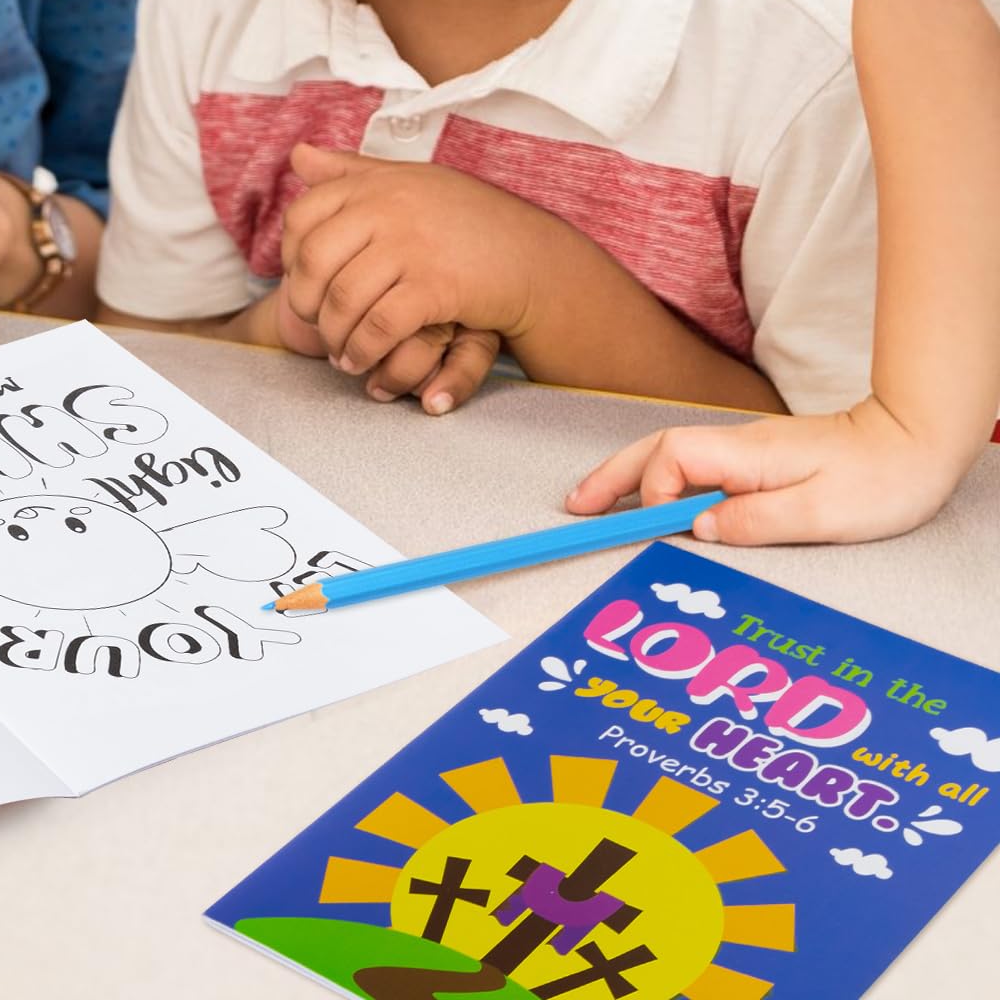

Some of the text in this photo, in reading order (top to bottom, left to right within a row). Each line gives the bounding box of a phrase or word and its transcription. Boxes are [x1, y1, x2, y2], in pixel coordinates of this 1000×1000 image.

[82, 446, 241, 513] light
[583, 599, 989, 807] LORD with all
[732, 614, 948, 716] Trust in the
[598, 725, 818, 833] Proverbs 3:5-6
[689, 717, 899, 833] HEART.
